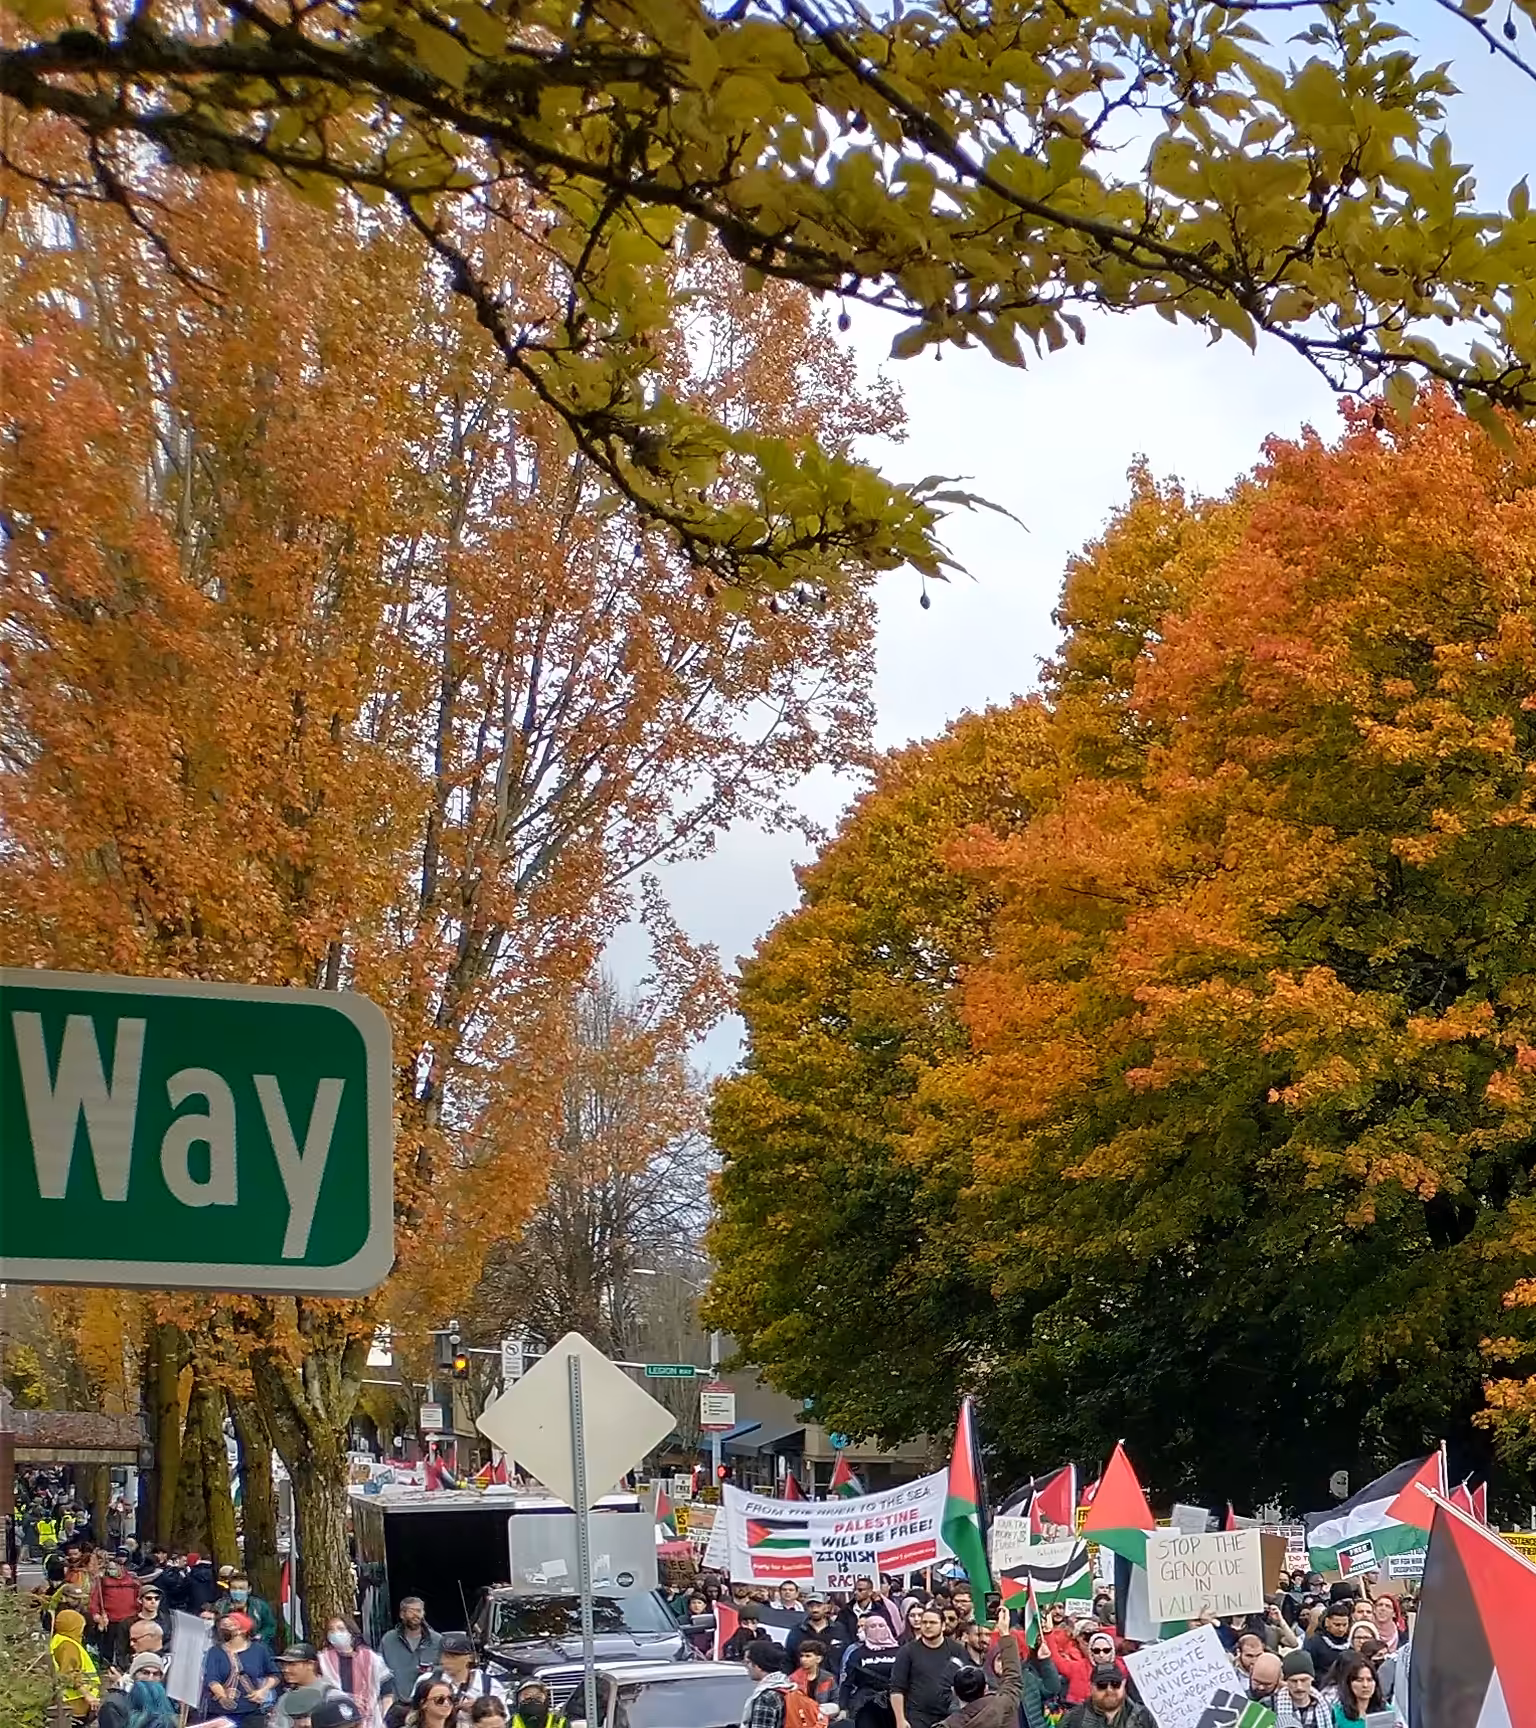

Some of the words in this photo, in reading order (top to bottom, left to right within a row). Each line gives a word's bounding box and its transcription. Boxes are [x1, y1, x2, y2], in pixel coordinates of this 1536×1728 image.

[11, 1011, 346, 1259] Way
[648, 1367, 677, 1375] LEGION
[744, 1502, 783, 1516] FROM
[881, 1495, 904, 1507] THE
[821, 1534, 858, 1548] WILL
[863, 1531, 884, 1544] BE
[889, 1519, 932, 1540] FREE!
[833, 1508, 919, 1534] PALESTINE
[815, 1551, 876, 1563] ZIONISM
[1156, 1536, 1201, 1560] STOP
[1214, 1532, 1247, 1553] THE
[838, 1563, 849, 1574] IS
[1160, 1557, 1246, 1581] GENOCIDE
[1195, 1576, 1211, 1592] IN
[1138, 1646, 1205, 1688] IMMEDIATE
[1149, 1661, 1225, 1700] UNIVERSAL
